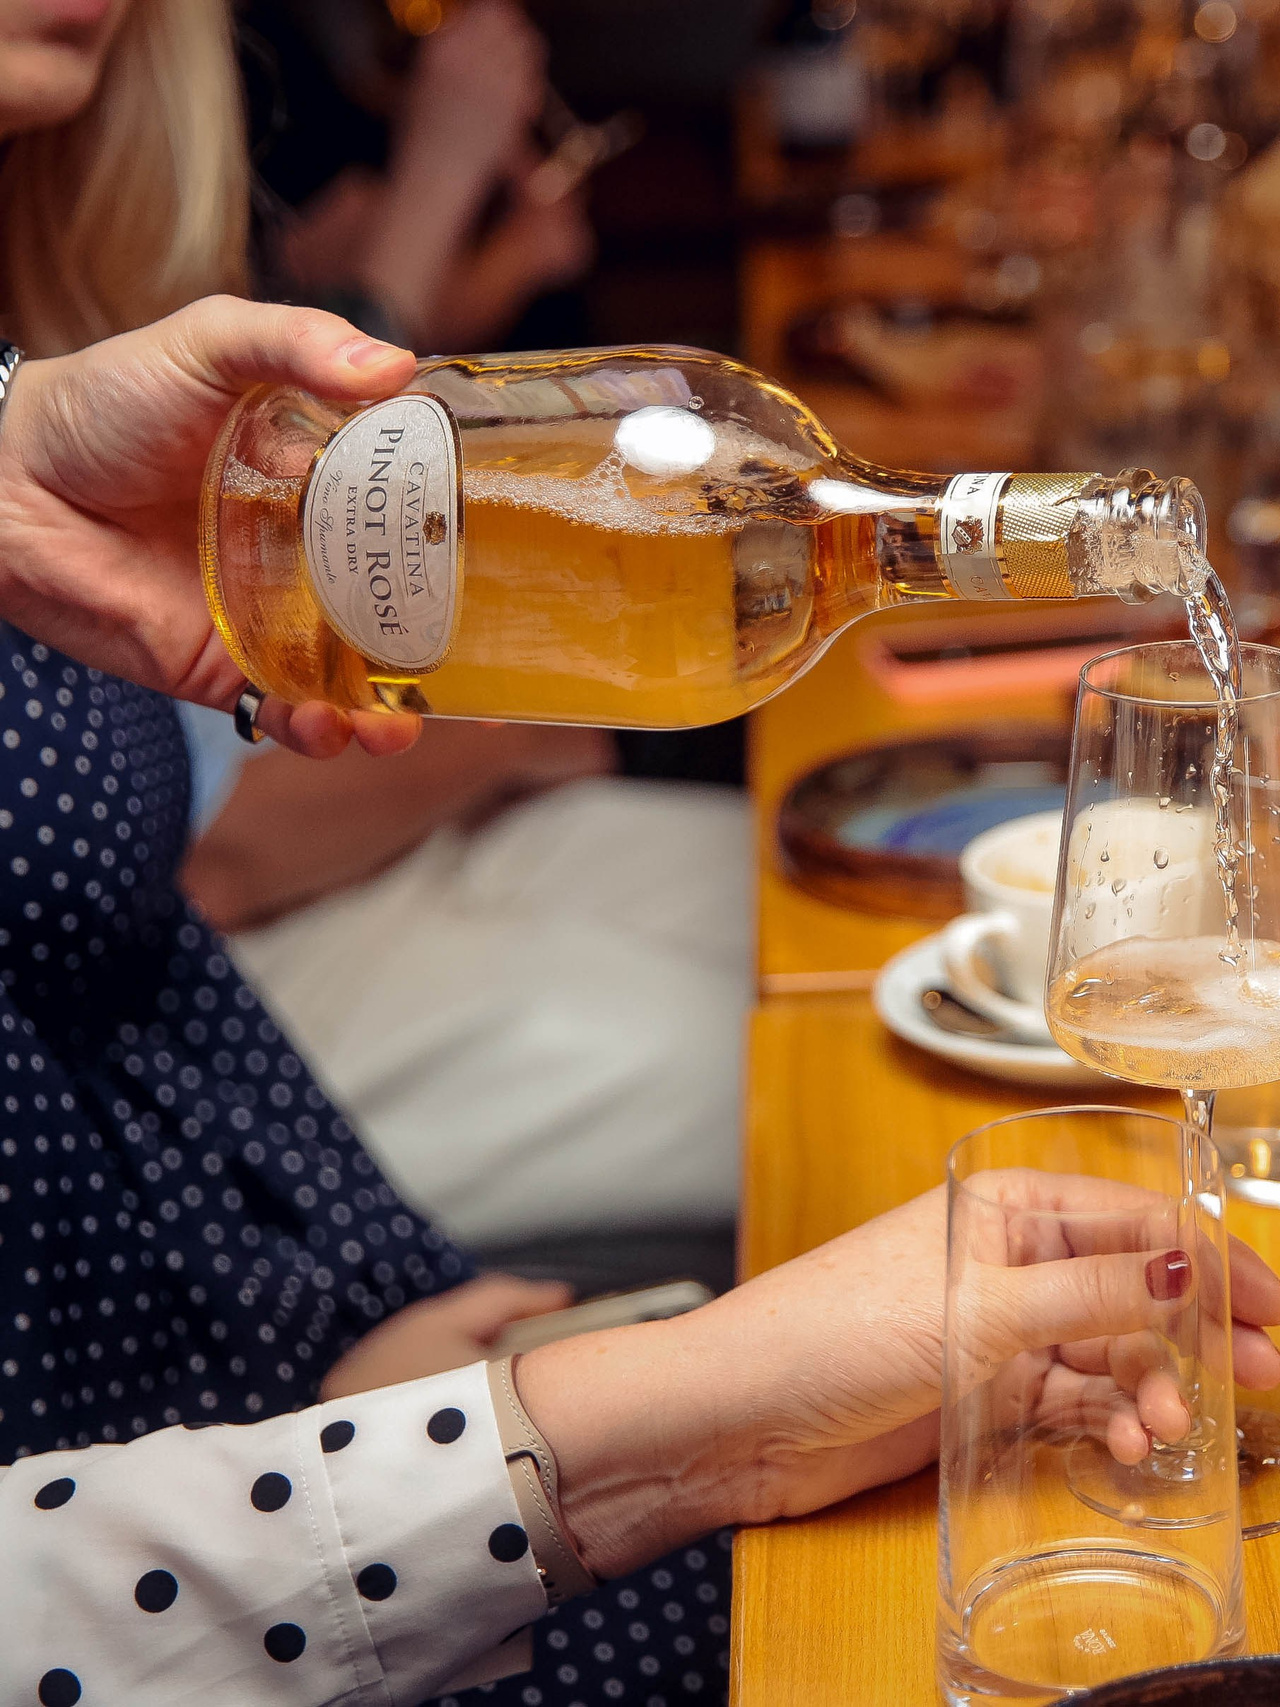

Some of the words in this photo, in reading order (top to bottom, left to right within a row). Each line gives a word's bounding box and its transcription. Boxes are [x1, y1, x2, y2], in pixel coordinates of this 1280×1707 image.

[322, 469, 343, 504] Vino
[364, 427, 405, 536] PINOT
[967, 473, 990, 495] INA
[346, 485, 358, 537] EXTRA
[404, 461, 425, 597] CAVATINA
[347, 543, 359, 575] DRY
[366, 549, 409, 636] ROSÉ
